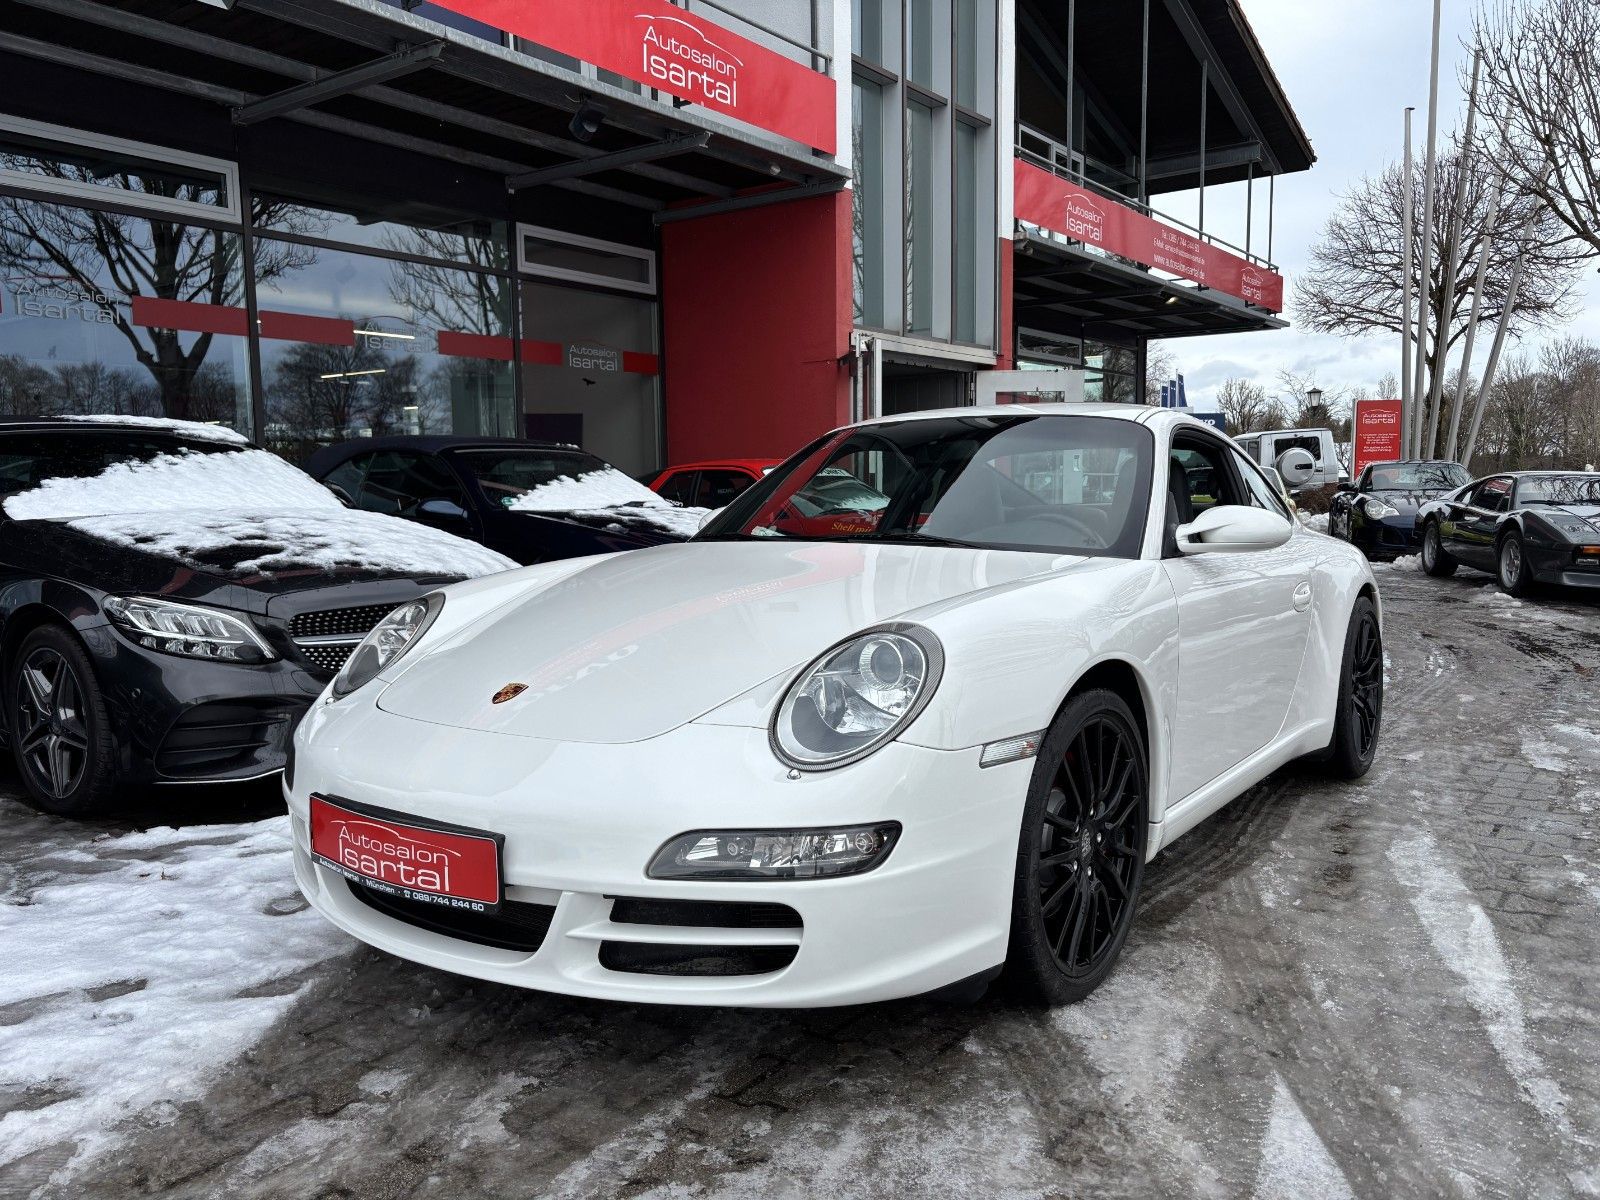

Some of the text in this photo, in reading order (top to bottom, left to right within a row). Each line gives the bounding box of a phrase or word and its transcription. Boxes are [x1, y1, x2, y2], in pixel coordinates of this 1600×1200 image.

[644, 26, 737, 78] Autosalon
[643, 43, 737, 107] Isartal
[1067, 201, 1102, 224] Autosalon
[1067, 212, 1102, 241] Isartal
[17, 278, 119, 304] Autosalon
[15, 295, 120, 324] Isartal
[569, 345, 617, 358] Autosalon
[569, 354, 617, 371] Isartal
[832, 522, 855, 531] Shell
[339, 825, 448, 866] Autosalon
[339, 838, 449, 892] Isartal
[366, 878, 395, 893] München
[412, 893, 449, 905] 089/744
[451, 899, 470, 909] 244
[471, 903, 484, 911] 60
